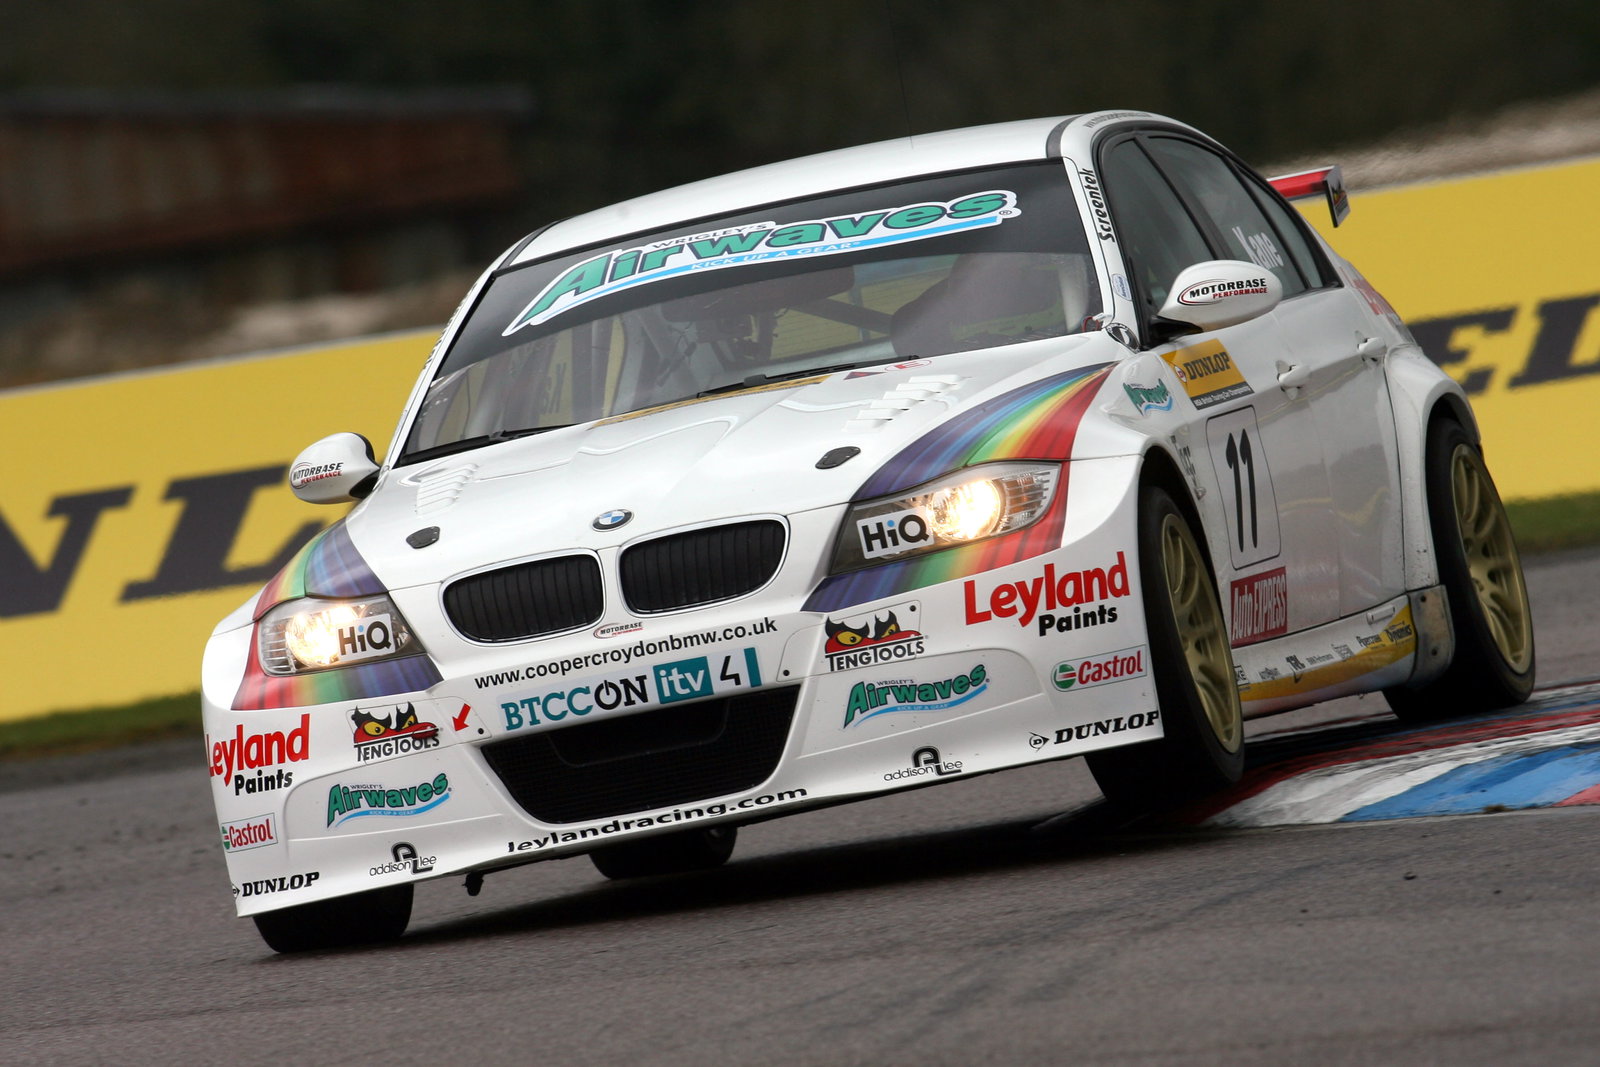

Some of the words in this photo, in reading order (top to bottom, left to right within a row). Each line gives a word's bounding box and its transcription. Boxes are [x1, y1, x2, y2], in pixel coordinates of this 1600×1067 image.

[1080, 168, 1116, 243] Screentek
[652, 223, 768, 248] WRIGLEY'S
[1232, 226, 1284, 270] Kane
[514, 192, 1008, 326] Airwaves
[691, 257, 735, 270] KICK
[743, 252, 769, 263] UP
[775, 250, 789, 258] A
[802, 242, 853, 256] GEAR
[1189, 278, 1267, 298] MOTORBASE
[1212, 287, 1268, 299] PERFORMANCE
[1183, 351, 1231, 380] DUNLOP
[1226, 428, 1258, 553] 11
[861, 513, 930, 552] HiQ
[963, 550, 1130, 628] Leyland
[1232, 584, 1253, 640] Auto
[1253, 573, 1286, 635] EXPRESS
[337, 619, 393, 656] HiQ
[600, 621, 643, 635] MOTORBASE
[1038, 604, 1118, 637] Paints
[474, 616, 778, 690] www.coopercroydonbmw.co.uk
[1077, 650, 1144, 685] Castrol
[658, 661, 705, 699] itv
[719, 654, 742, 686] 4
[877, 679, 914, 687] WRIGLEY'S
[843, 664, 987, 729] Airwaves
[1053, 710, 1159, 745] DUNLOP
[206, 713, 311, 787] Leyland
[234, 768, 294, 796] Paints
[883, 766, 934, 781] addison
[942, 760, 963, 771] lee
[326, 773, 449, 828] Airwaves
[229, 818, 274, 849] Castrol
[507, 787, 808, 853] leylandracing.com
[369, 861, 411, 876] addison
[419, 855, 437, 867] lee
[242, 871, 320, 897] DUNLOP
